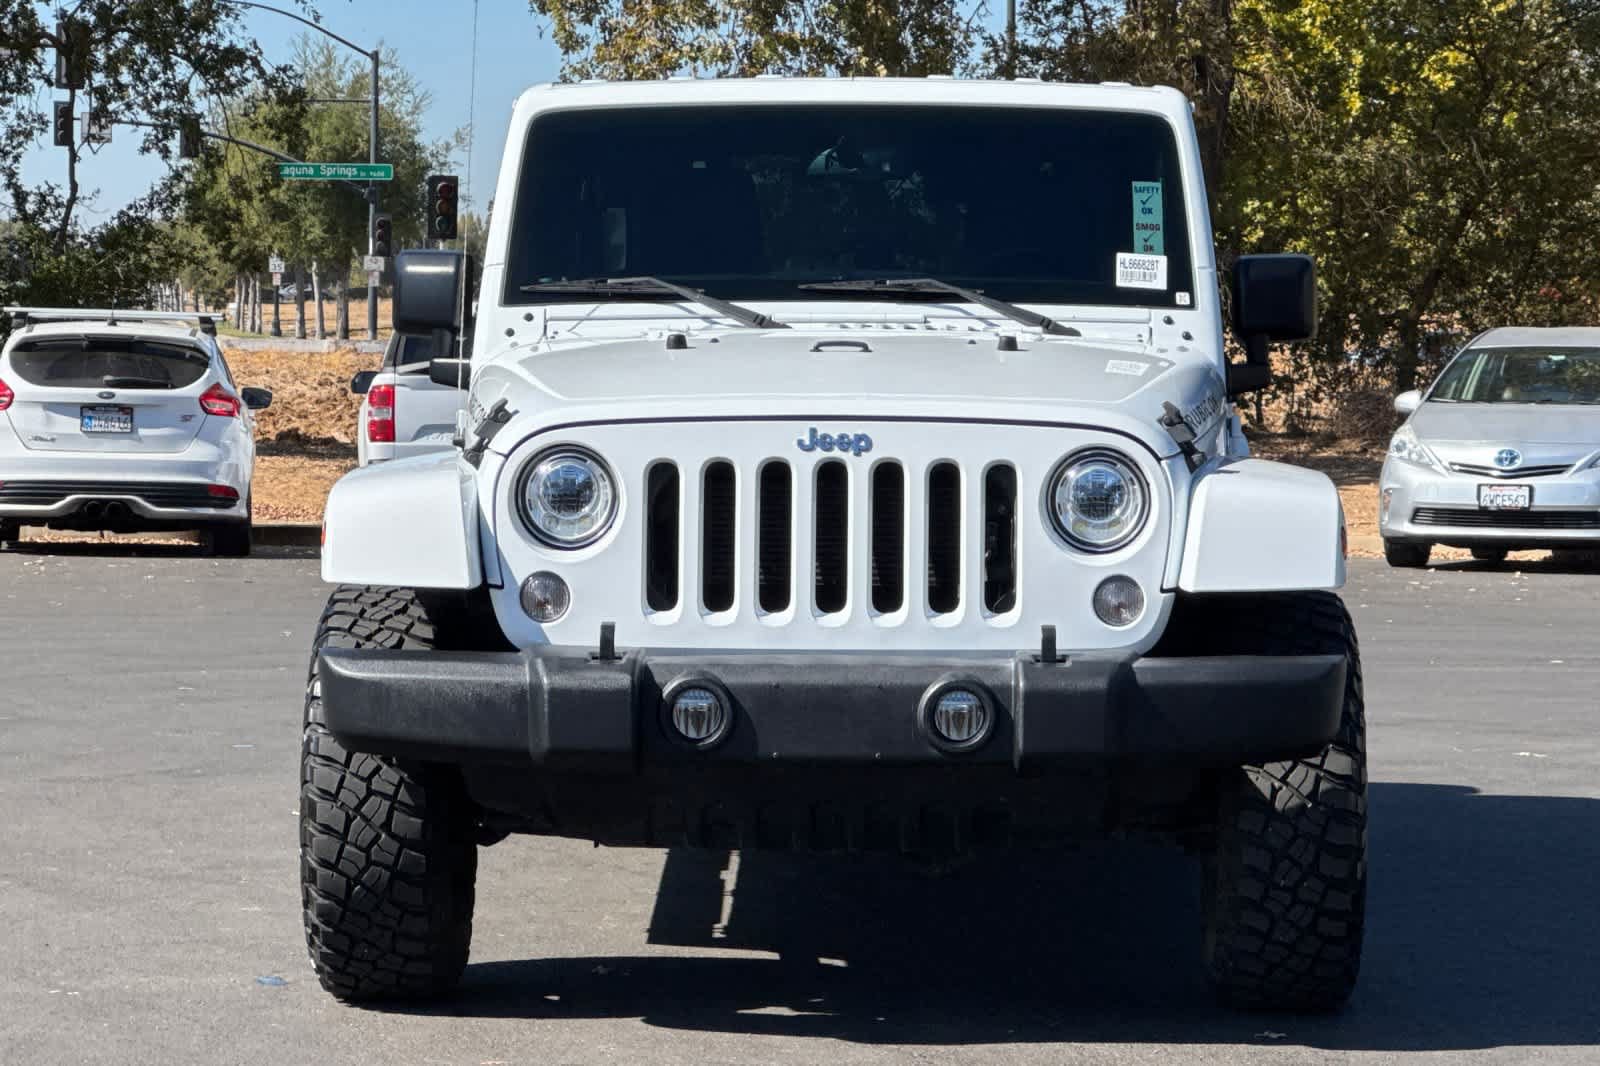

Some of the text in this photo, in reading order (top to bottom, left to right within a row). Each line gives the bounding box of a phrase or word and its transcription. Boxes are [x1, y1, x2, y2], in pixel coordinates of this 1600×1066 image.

[320, 165, 358, 179] Springs
[1133, 185, 1160, 194] SAFETY
[1141, 206, 1153, 215] OK
[1135, 222, 1161, 232] SMOG
[1143, 243, 1154, 253] OK
[271, 262, 282, 271] 35
[797, 426, 873, 457] Jeep
